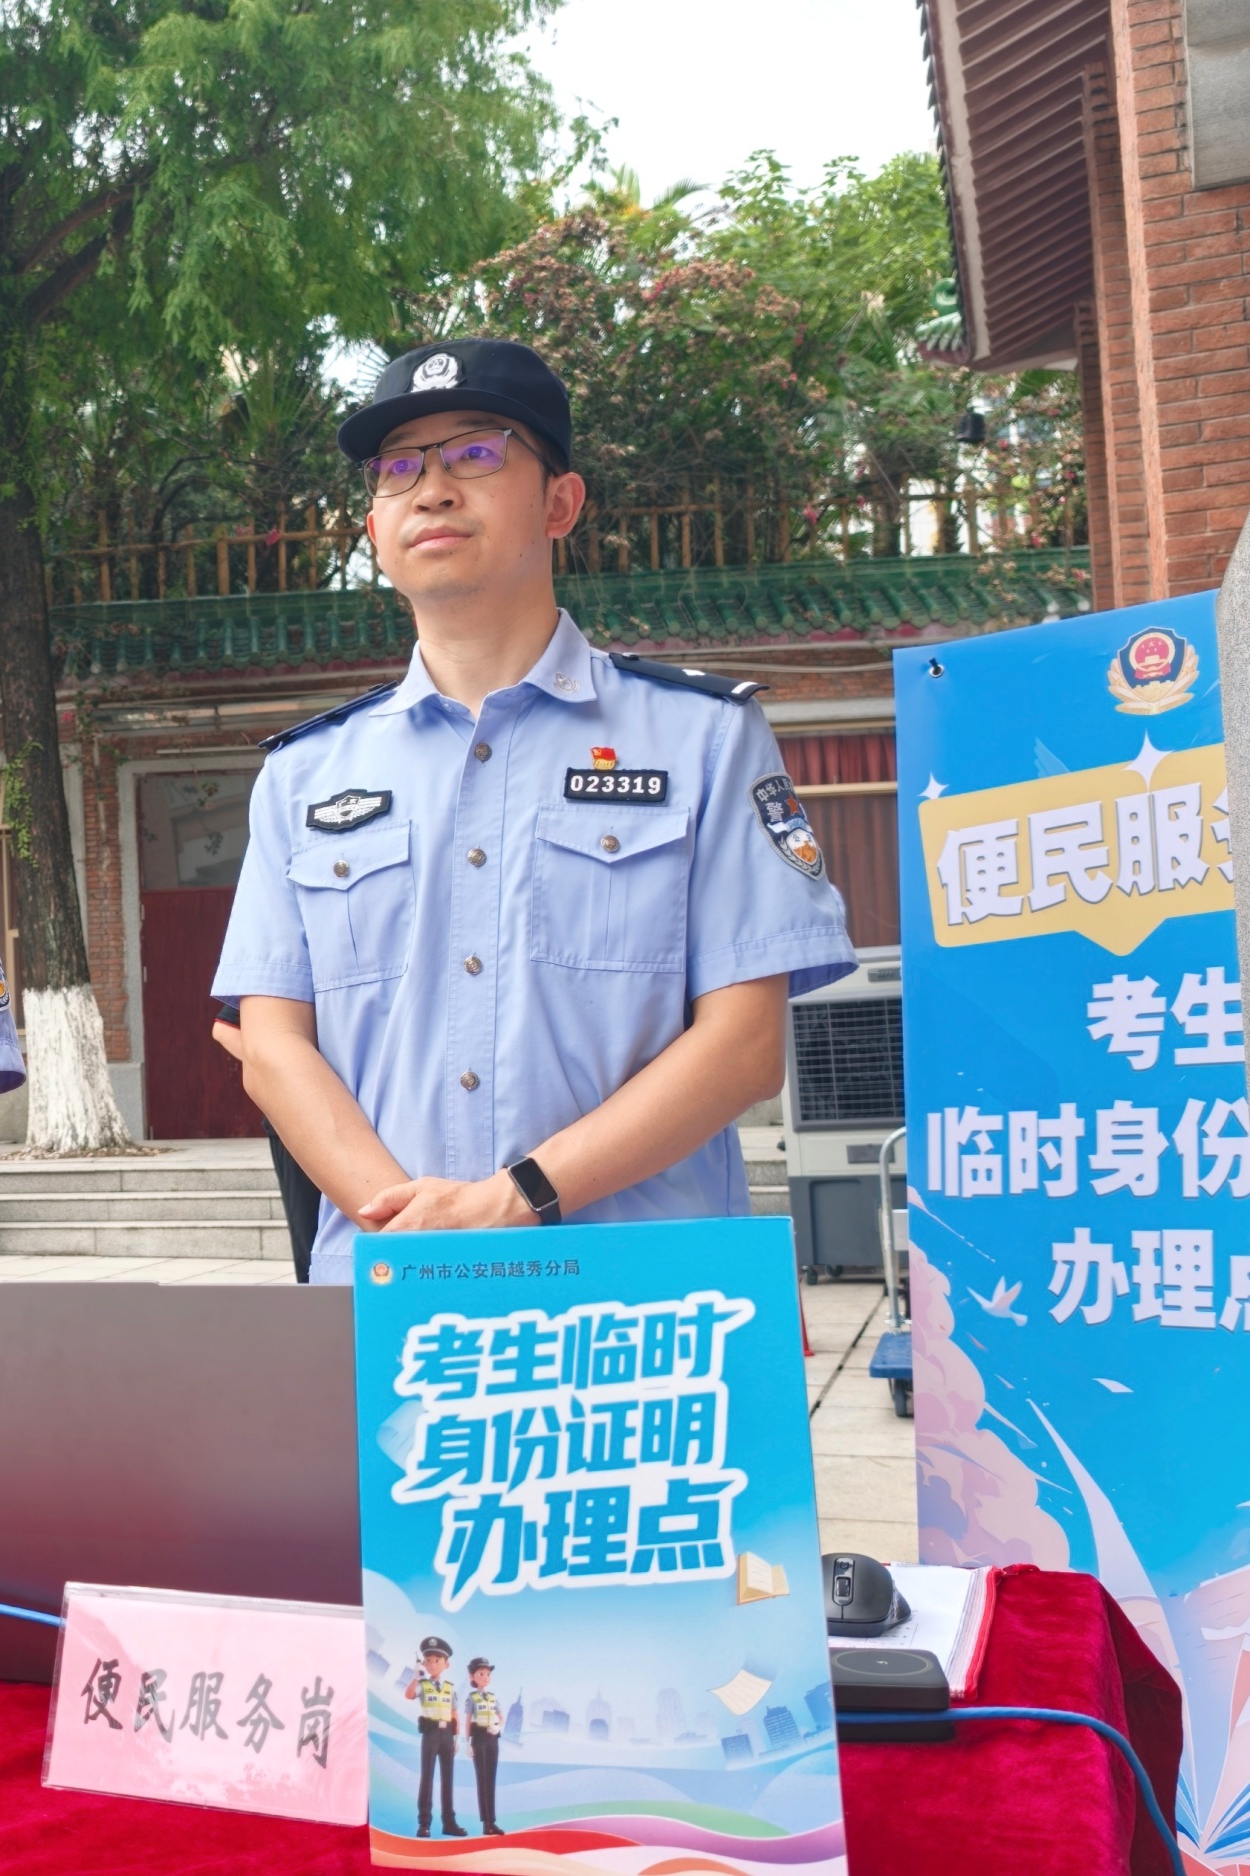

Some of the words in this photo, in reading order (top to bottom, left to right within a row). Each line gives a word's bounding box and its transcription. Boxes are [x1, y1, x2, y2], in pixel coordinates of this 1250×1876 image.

[570, 775, 661, 795] 023319
[937, 783, 1234, 925] 便民服
[1086, 967, 1245, 1072] 考生
[927, 1097, 1250, 1199] 临时身份
[401, 1259, 580, 1281] 广州市公安局越秀分局
[402, 1302, 749, 1402] 考生临时
[402, 1391, 718, 1495] 身份证明
[447, 1477, 740, 1601] 办理点
[81, 1658, 334, 1769] 便民服务岗
